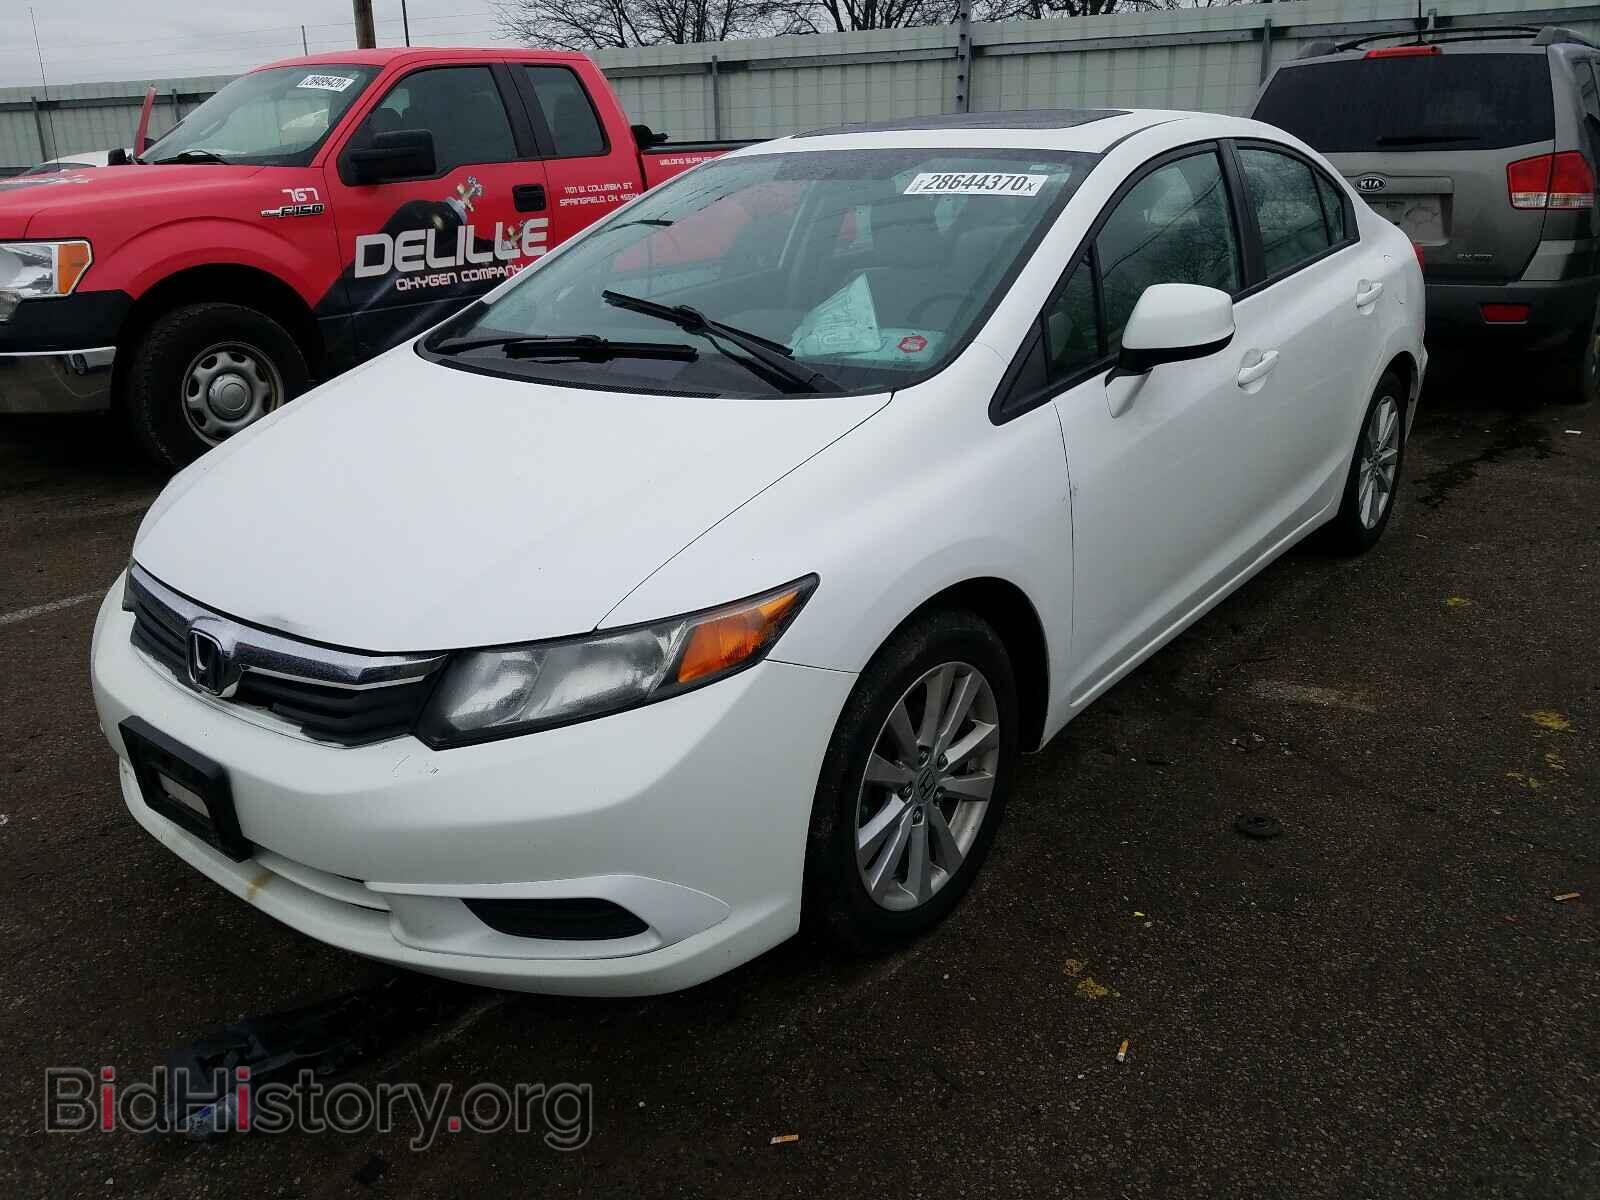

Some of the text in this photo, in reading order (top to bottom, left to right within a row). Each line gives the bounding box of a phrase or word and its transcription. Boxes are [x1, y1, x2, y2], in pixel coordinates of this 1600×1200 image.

[587, 183, 621, 192] COLUMBIA
[1360, 180, 1380, 189] KIA
[281, 187, 319, 202] 767
[354, 217, 549, 278] DELILLE
[396, 271, 458, 291] OXYGEN
